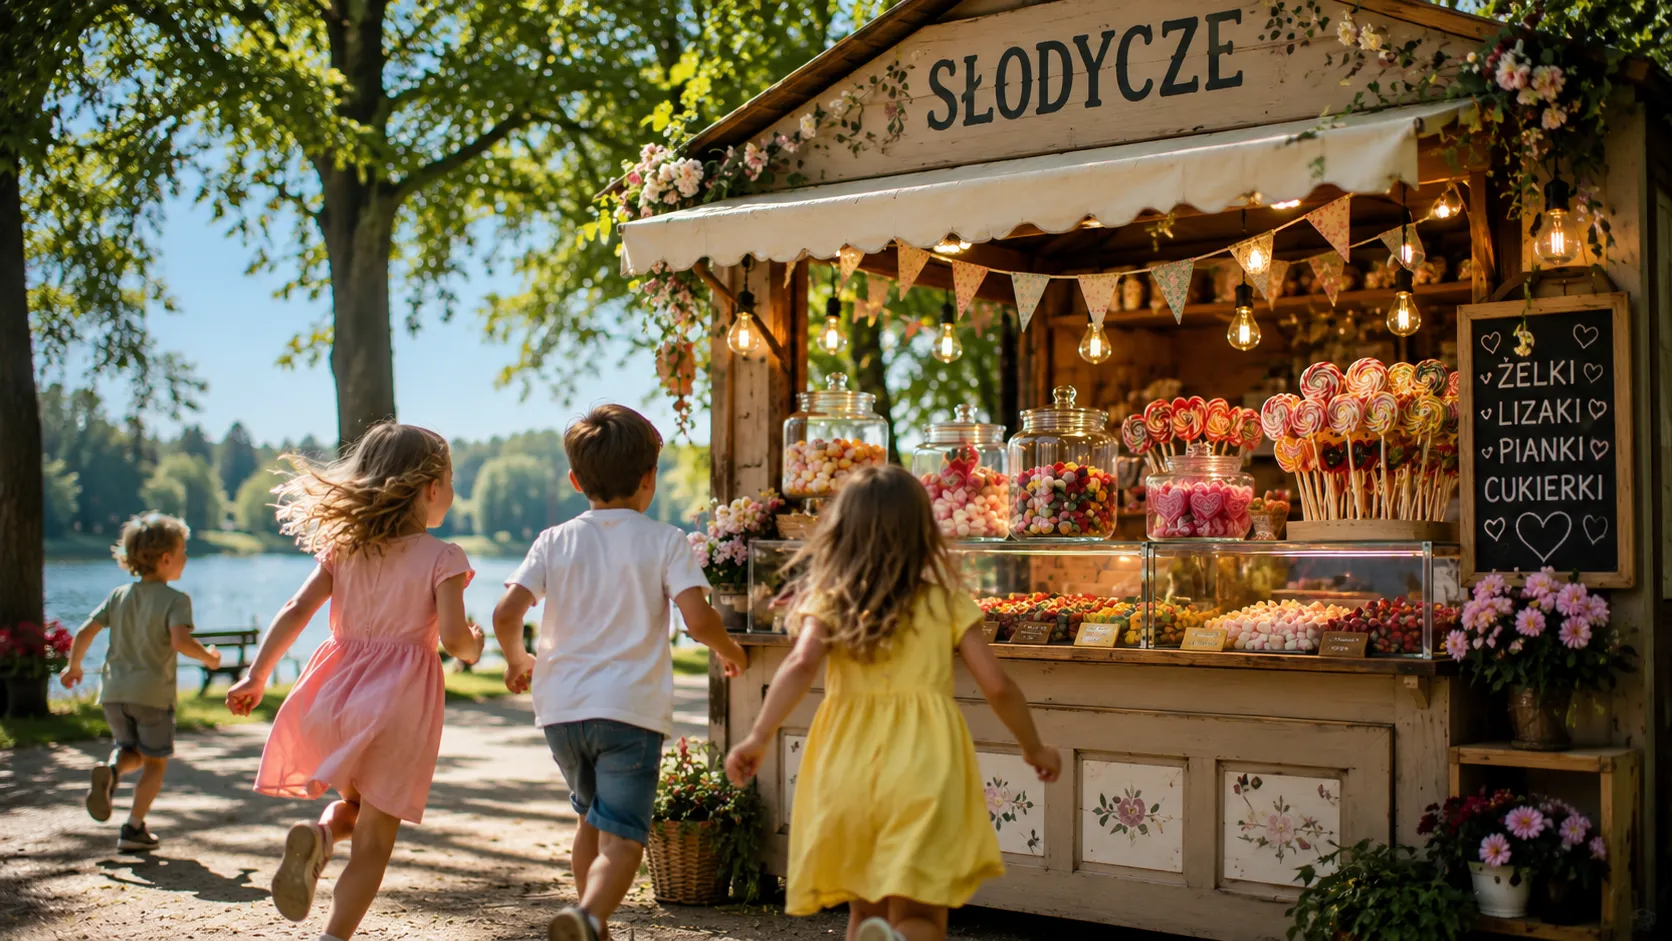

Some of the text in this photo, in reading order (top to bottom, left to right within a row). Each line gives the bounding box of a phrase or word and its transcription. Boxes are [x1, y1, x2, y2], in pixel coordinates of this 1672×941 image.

[927, 8, 1243, 131] SŁODYCZE
[1498, 399, 1580, 426] LIZAKI
[1499, 437, 1583, 464] PIANKI
[1484, 475, 1603, 503] CUKIERKI
